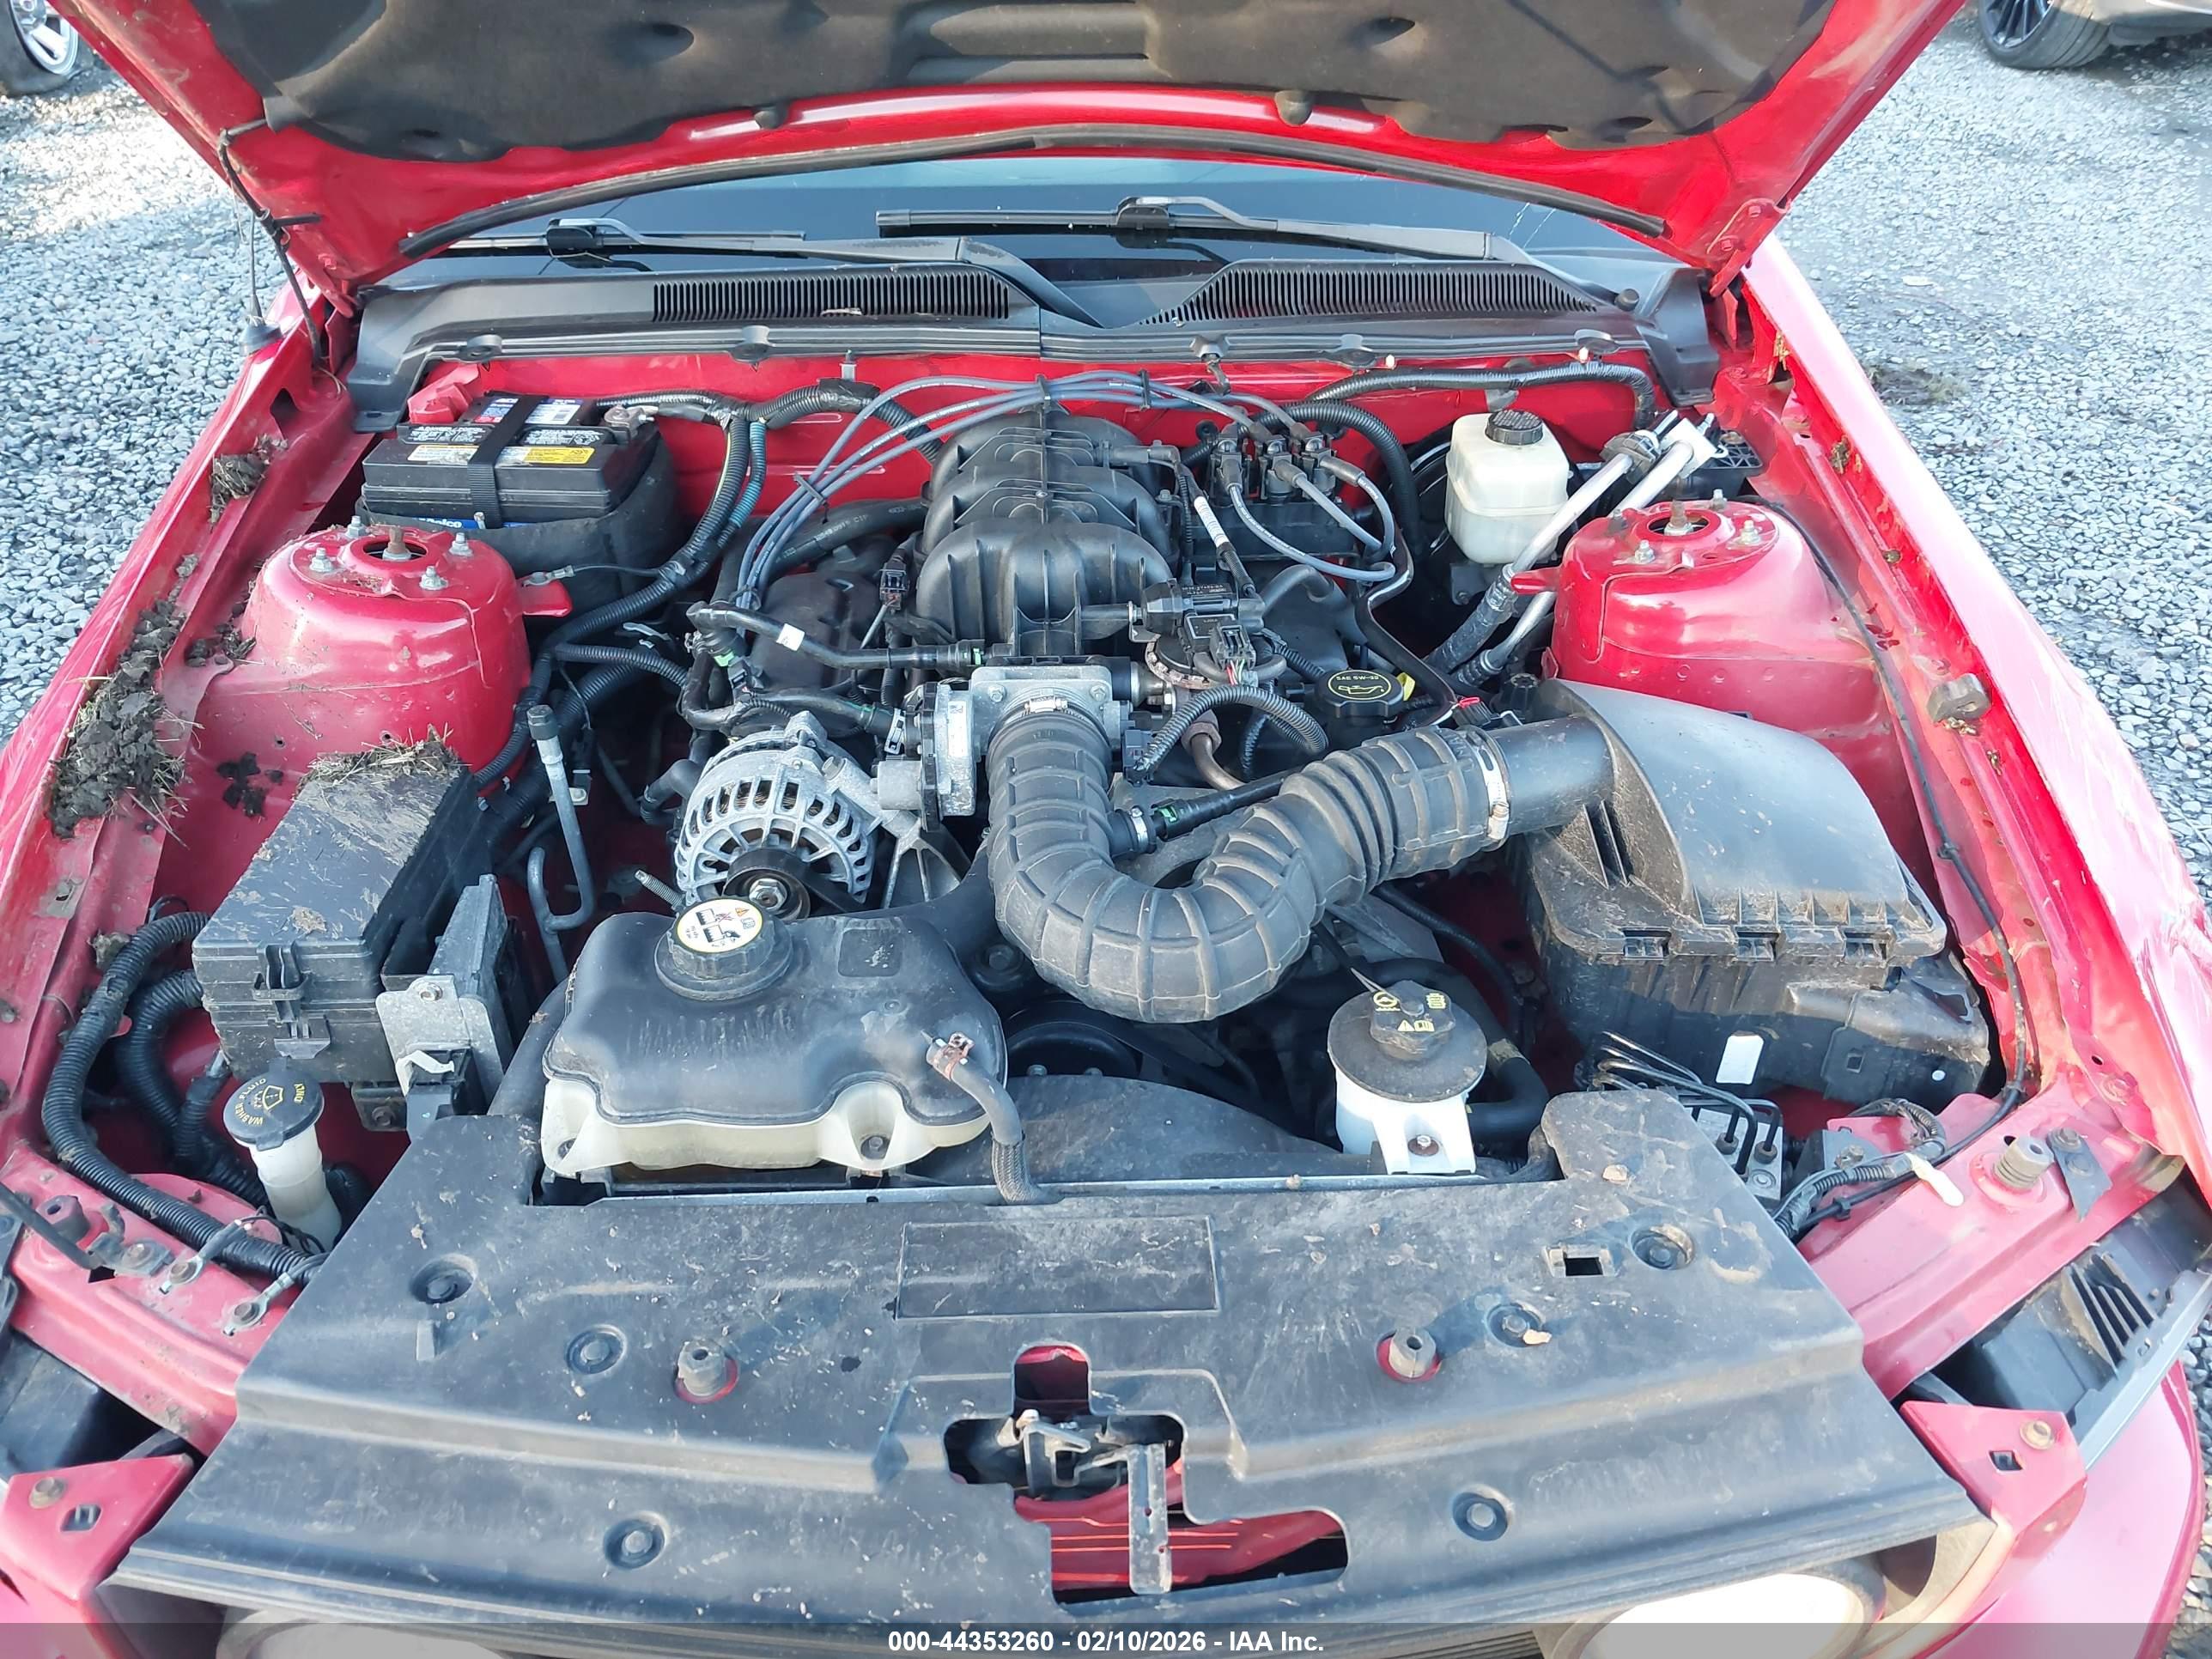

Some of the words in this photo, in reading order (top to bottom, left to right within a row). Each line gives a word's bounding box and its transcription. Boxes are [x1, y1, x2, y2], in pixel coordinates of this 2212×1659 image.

[239, 1079, 266, 1100] FLUID
[294, 1084, 305, 1103] ONLY
[234, 1102, 264, 1126] WASHER
